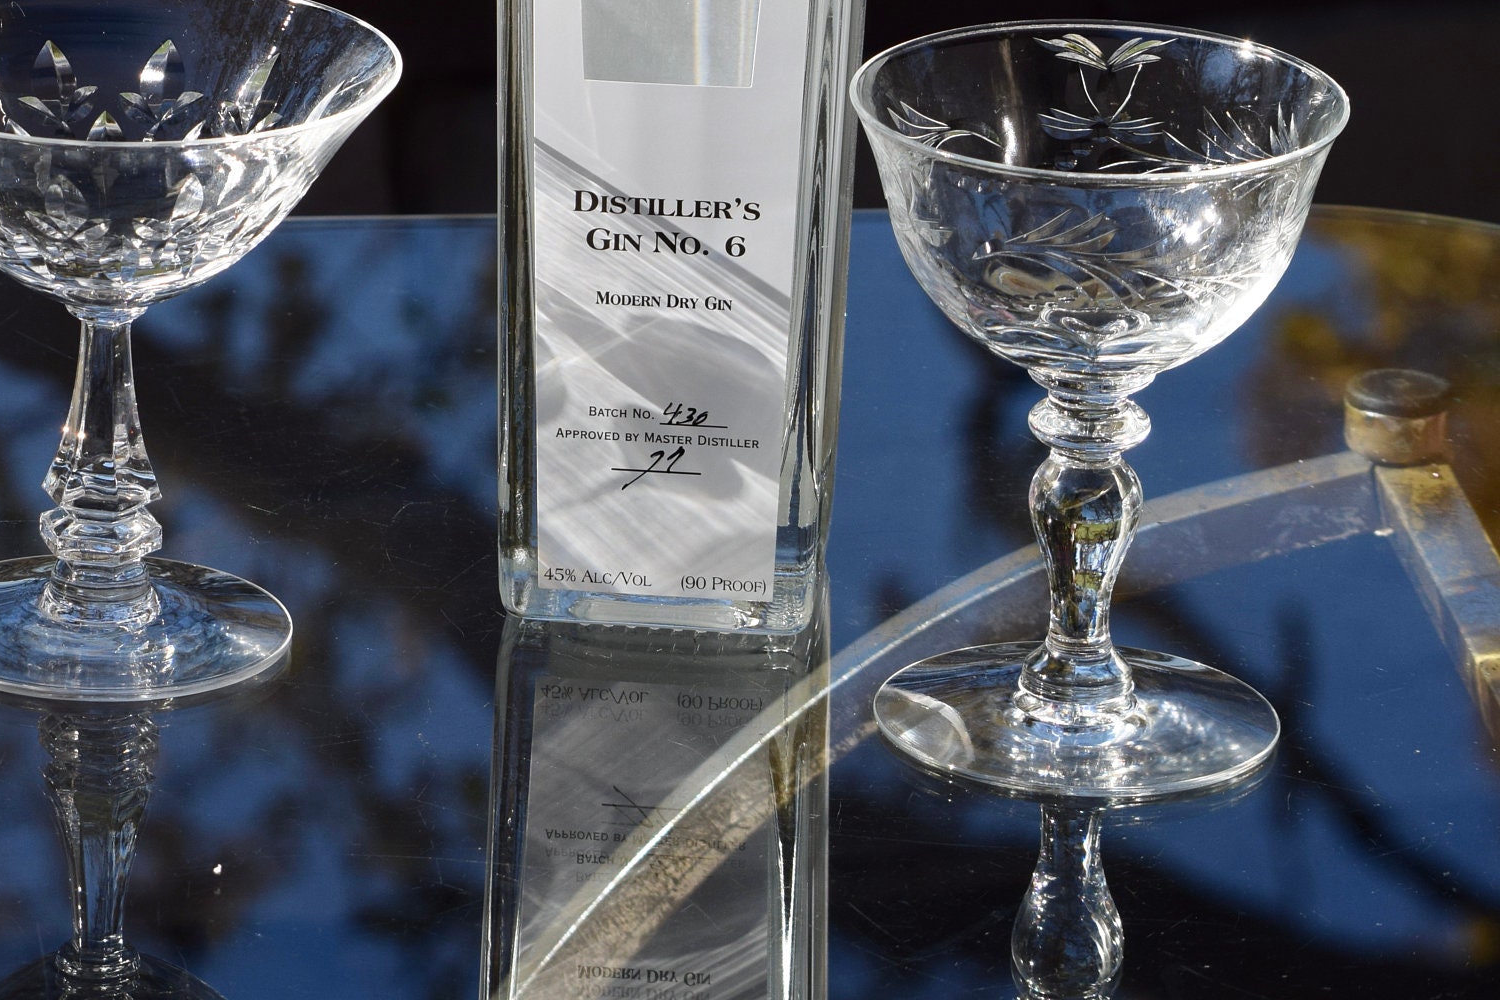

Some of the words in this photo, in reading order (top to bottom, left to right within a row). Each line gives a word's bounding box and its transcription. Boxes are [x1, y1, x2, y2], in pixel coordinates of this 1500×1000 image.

[573, 189, 761, 221] DISTILLER'S
[586, 227, 642, 252] GIN
[725, 235, 746, 258] 6
[595, 290, 661, 308] MODERN
[666, 293, 699, 310] DRY
[704, 295, 733, 311] GIN
[588, 406, 628, 419] BATCH
[555, 427, 620, 441] APPROVED
[644, 432, 692, 445] MASTER
[697, 435, 759, 449] DISTILLER
[544, 567, 576, 582] 45%
[581, 570, 652, 587] ALC/VOL
[680, 576, 707, 590] (90
[711, 577, 767, 593] PROOF)
